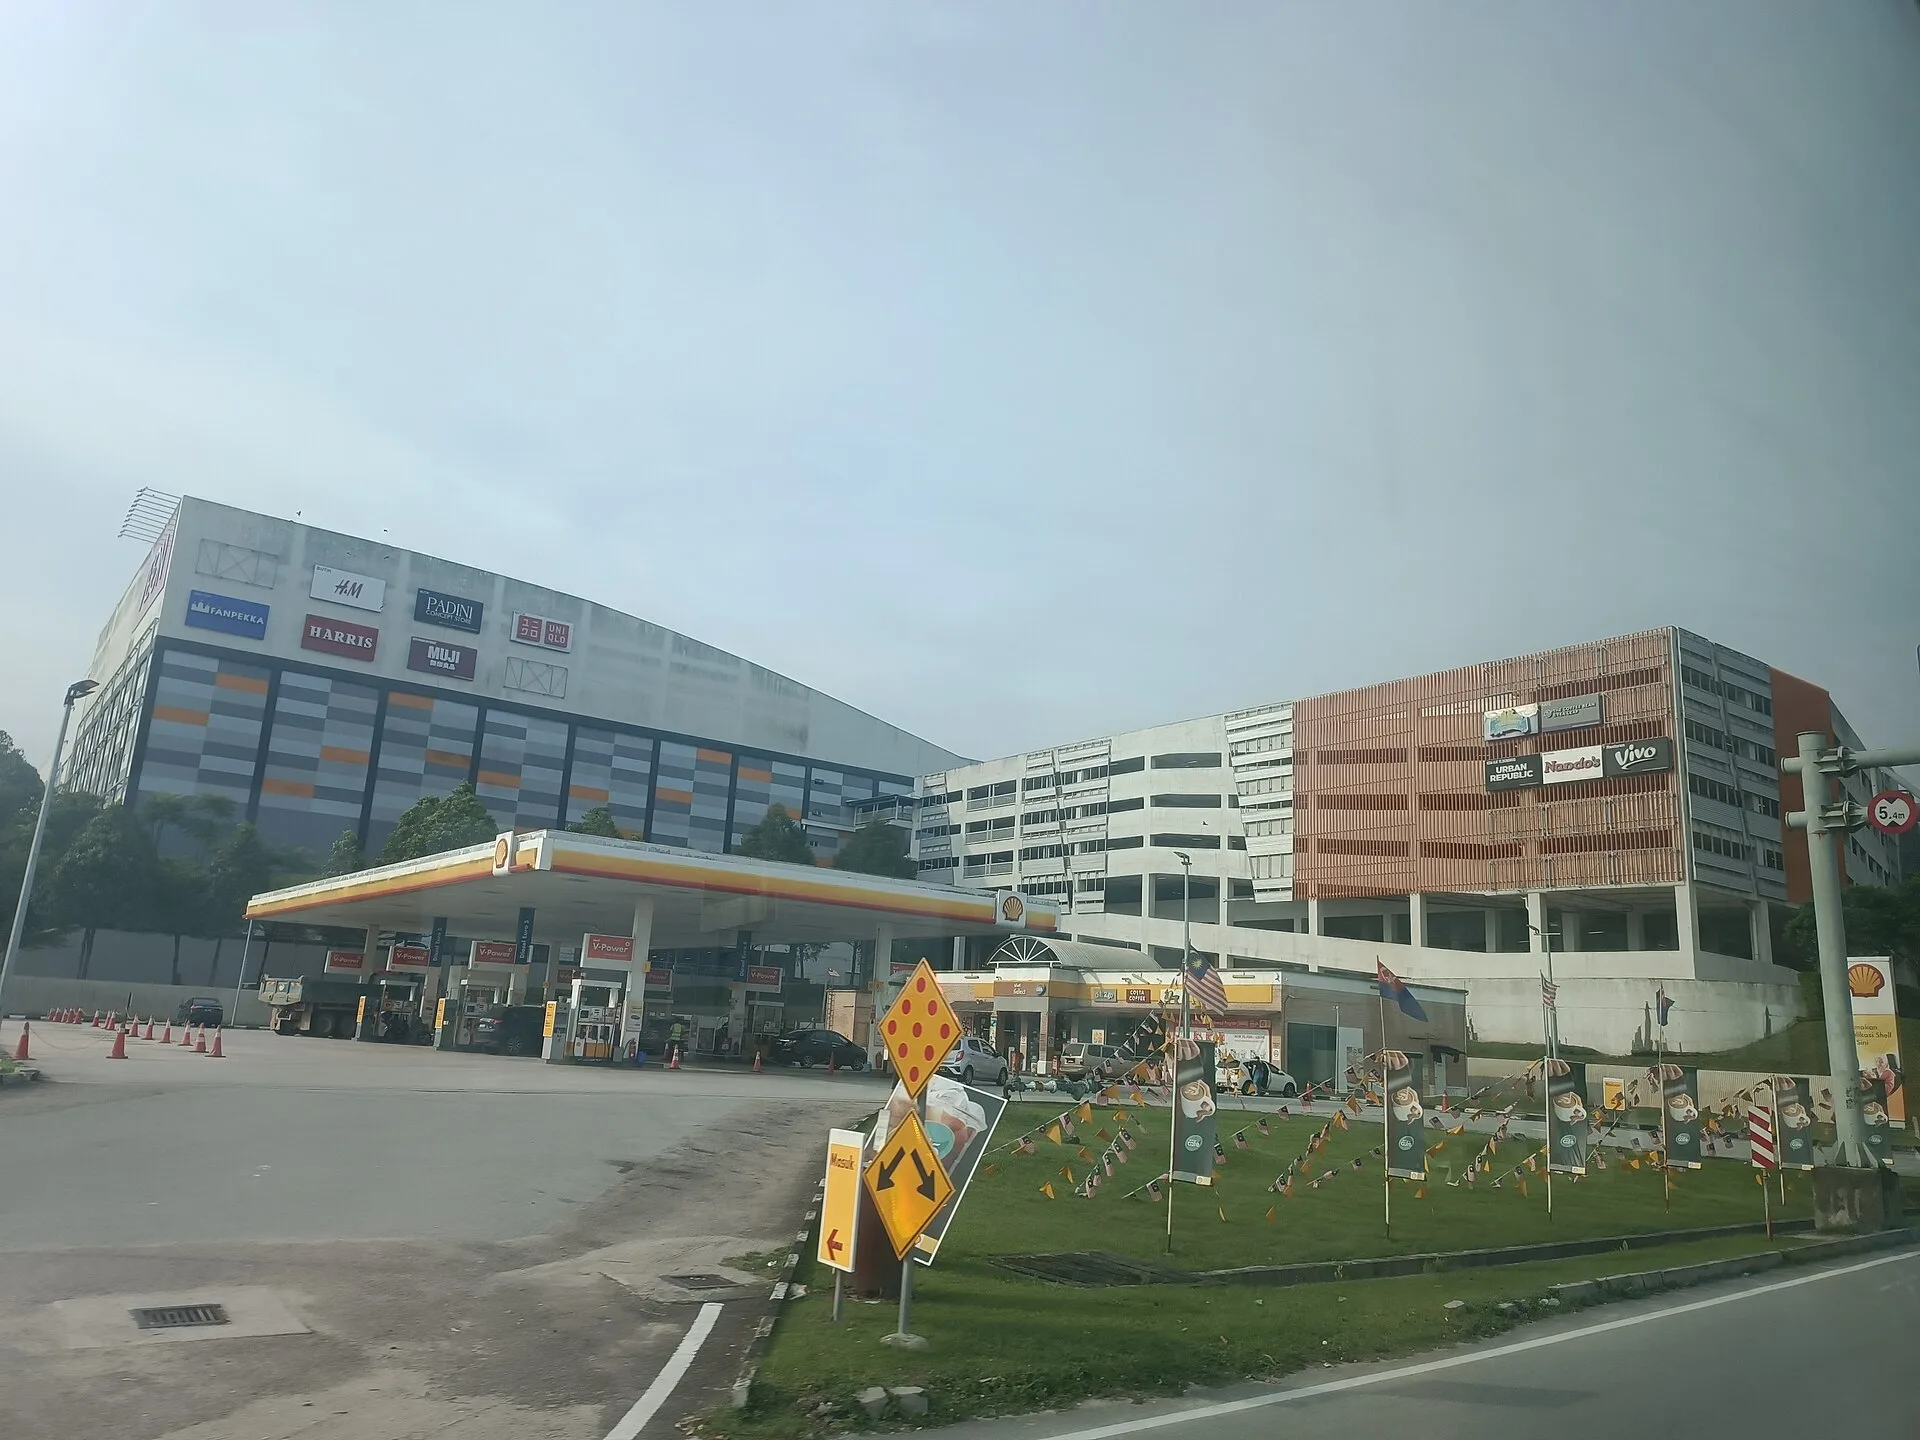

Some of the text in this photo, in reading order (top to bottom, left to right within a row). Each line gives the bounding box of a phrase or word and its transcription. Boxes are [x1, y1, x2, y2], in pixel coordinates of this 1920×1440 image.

[427, 596, 473, 619] PADINI
[210, 607, 264, 624] FANPEKKA
[425, 610, 471, 625] CONCEPT STORE
[549, 624, 565, 634] UNI
[310, 625, 373, 648] HARRIS
[548, 633, 566, 644] QLO
[427, 645, 460, 664] MUJI
[1615, 744, 1657, 766] Vivo
[1495, 763, 1528, 774] URBAN
[1544, 756, 1600, 773] Nando's
[1490, 770, 1534, 782] REPUBLIC
[480, 948, 511, 958] V-Power
[593, 942, 629, 953] V-Power
[333, 956, 359, 964] V-Power
[396, 952, 425, 961] V-Power
[750, 971, 776, 980] V-Power
[830, 1152, 855, 1170] Masuk
